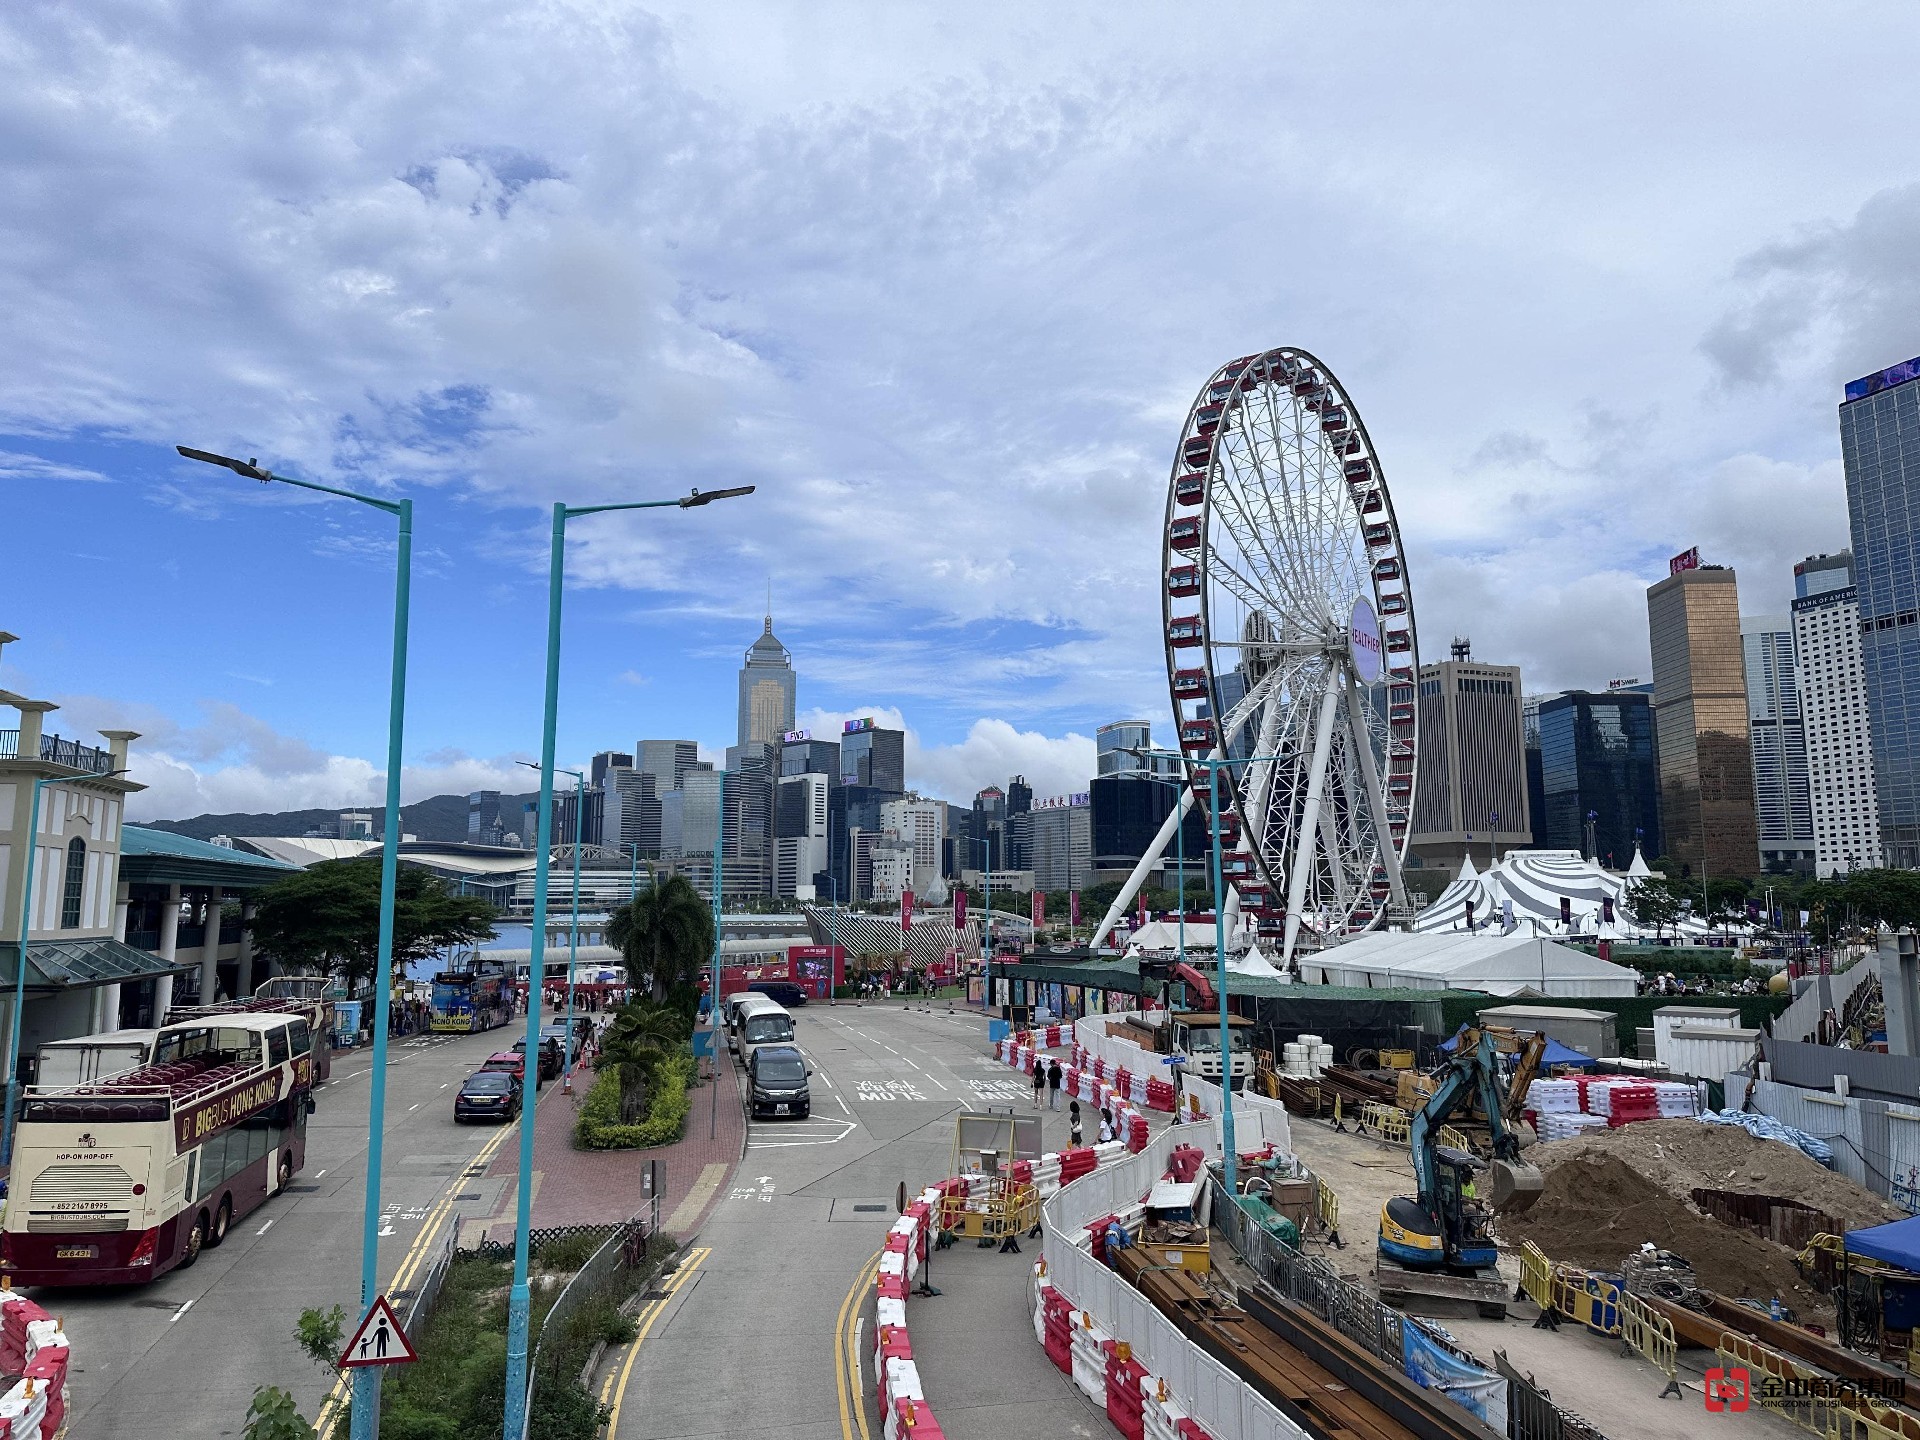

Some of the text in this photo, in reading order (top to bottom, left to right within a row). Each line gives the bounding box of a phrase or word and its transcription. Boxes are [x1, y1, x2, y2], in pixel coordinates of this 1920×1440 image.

[1797, 590, 1858, 609] BANK OF AMERIC
[1351, 627, 1380, 652] HEALTHIER
[340, 1034, 353, 1045] 15
[229, 1087, 254, 1120] HONG
[254, 1076, 276, 1106] KONG
[858, 1091, 928, 1101] SLOW
